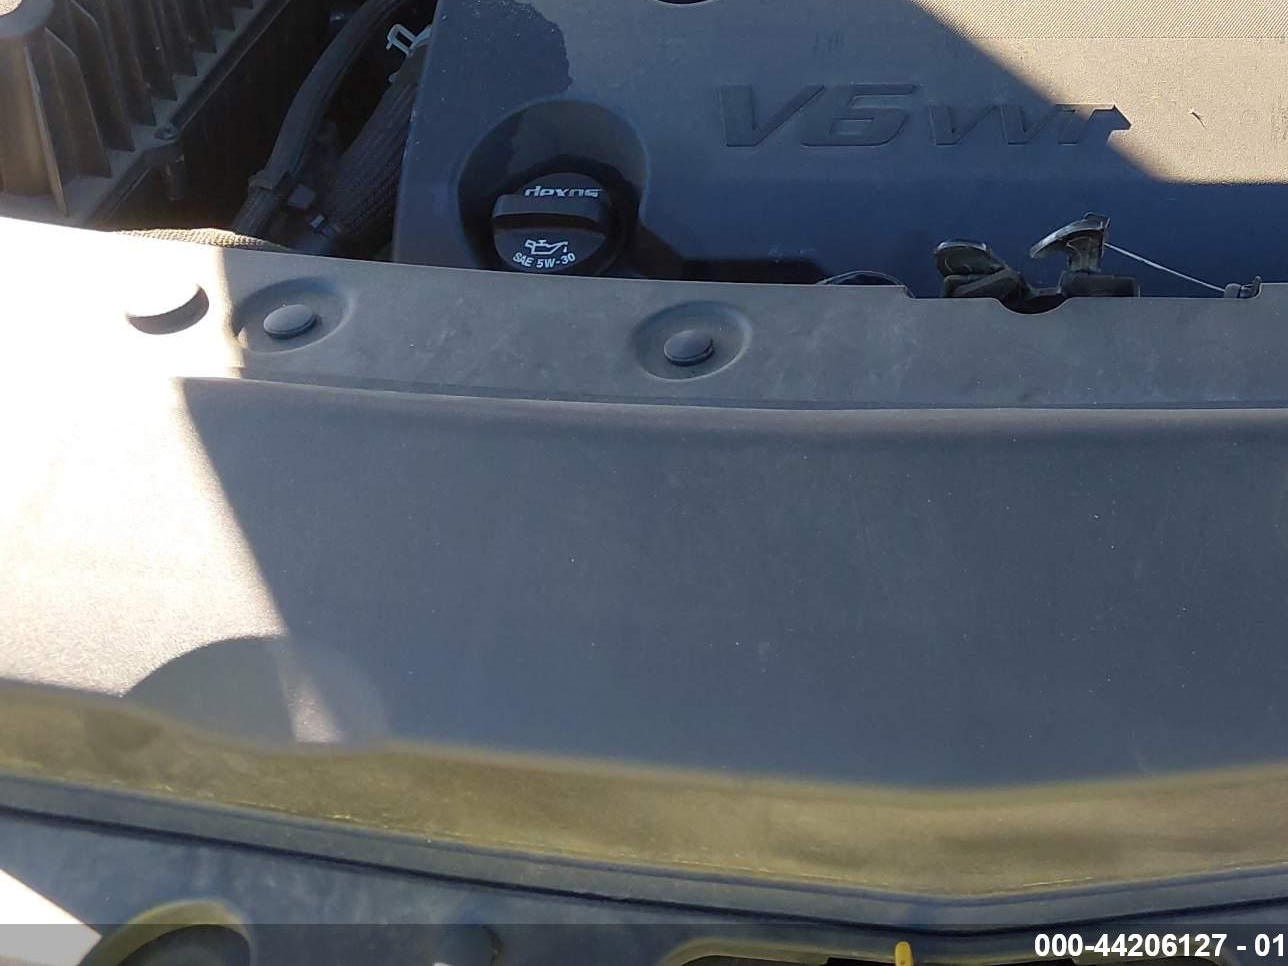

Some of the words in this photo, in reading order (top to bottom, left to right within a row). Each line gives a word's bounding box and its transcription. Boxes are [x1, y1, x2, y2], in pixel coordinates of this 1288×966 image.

[719, 83, 916, 148] V6
[512, 252, 534, 267] SAE
[536, 252, 576, 268] 5W-30
